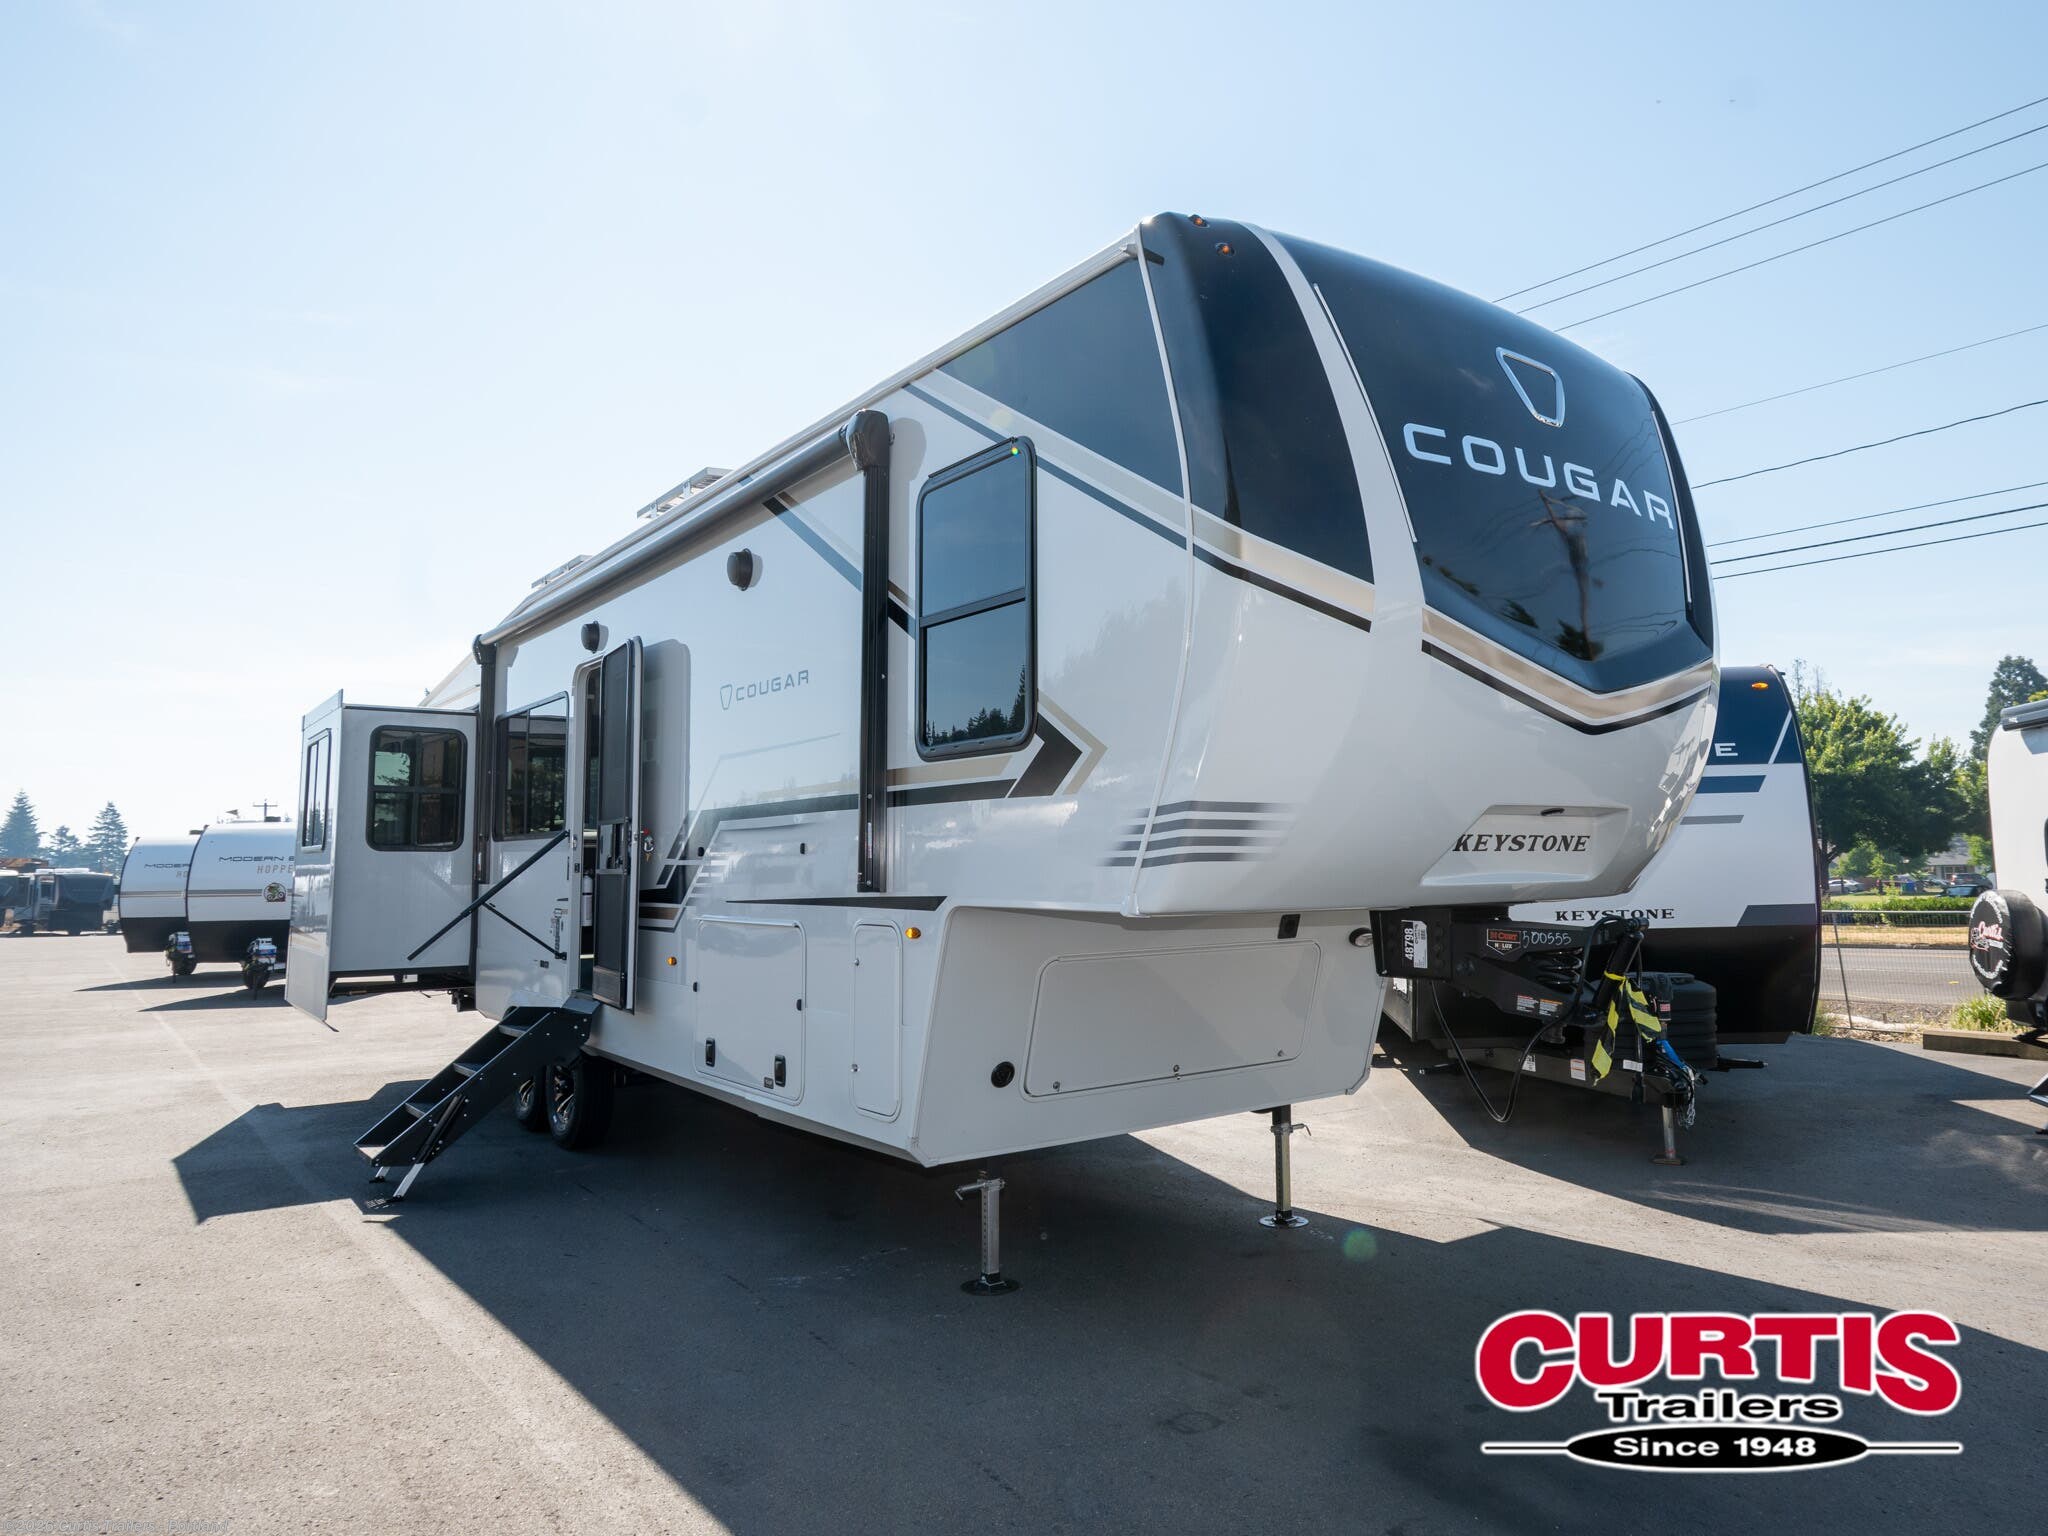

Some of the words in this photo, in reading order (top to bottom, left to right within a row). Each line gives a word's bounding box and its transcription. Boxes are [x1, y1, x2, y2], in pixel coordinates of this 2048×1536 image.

[1403, 422, 1675, 530] COUGAR
[736, 669, 809, 702] COUGAR
[1452, 834, 1591, 852] KEYSTONE
[257, 864, 295, 874] HOPPE
[1404, 928, 1414, 960] 48798
[1522, 930, 1572, 949] 500555
